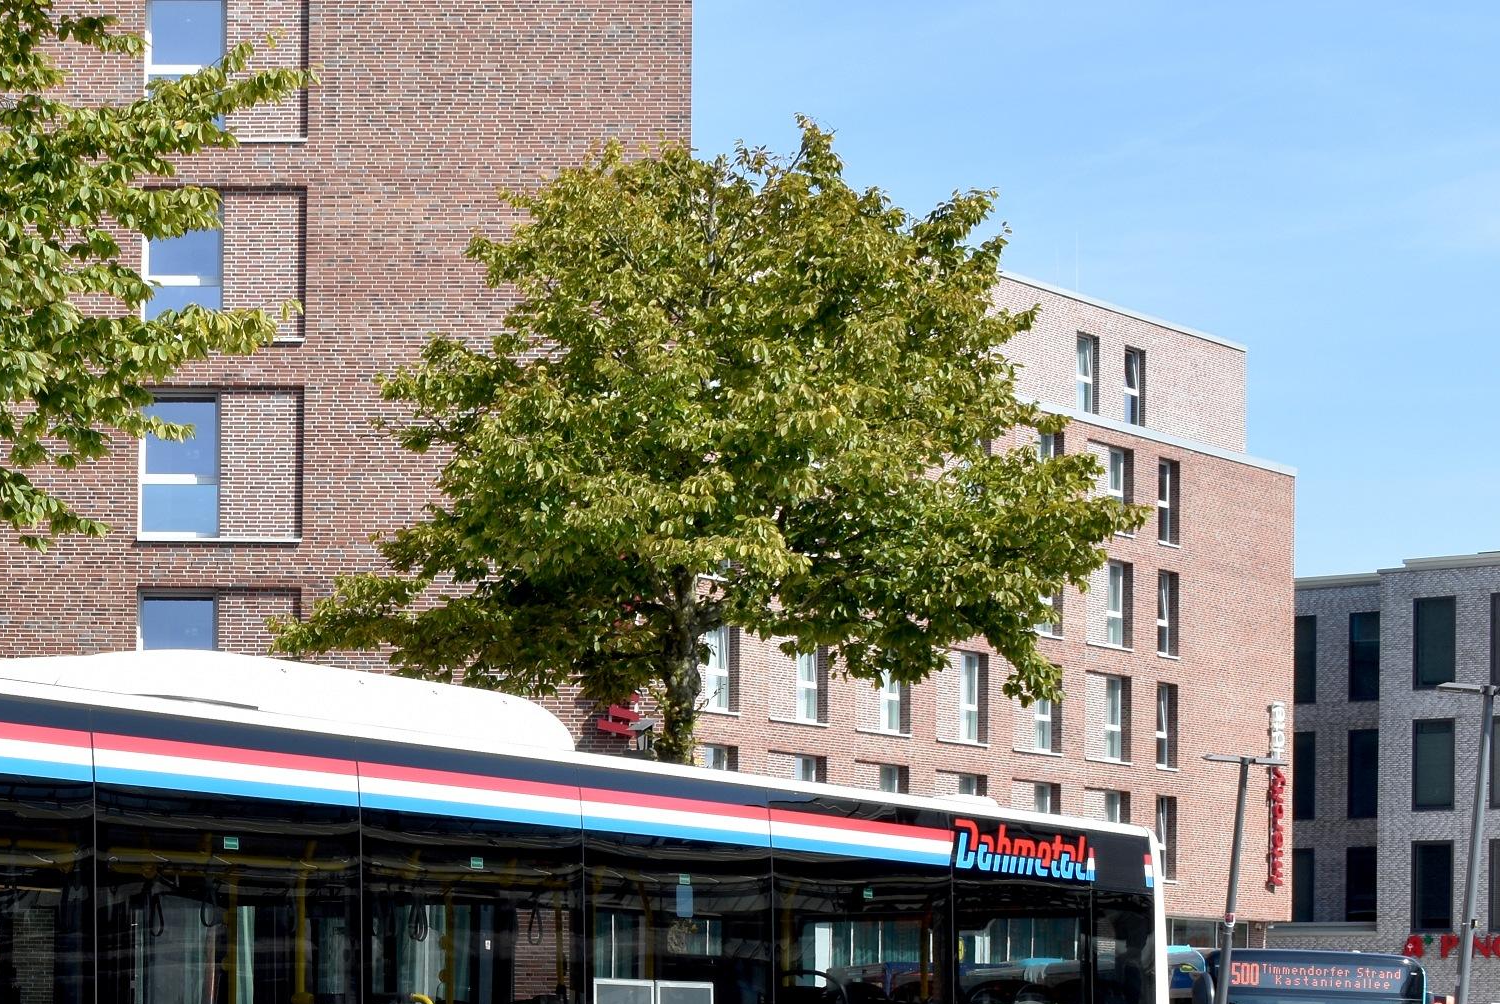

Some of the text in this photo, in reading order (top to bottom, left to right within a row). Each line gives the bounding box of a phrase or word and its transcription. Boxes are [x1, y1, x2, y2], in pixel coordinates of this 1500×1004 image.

[955, 818, 1089, 881] Dahmetal
[1231, 962, 1401, 986] 500 Timmendorfer Strand
[1275, 975, 1390, 990] Kastanienallee
